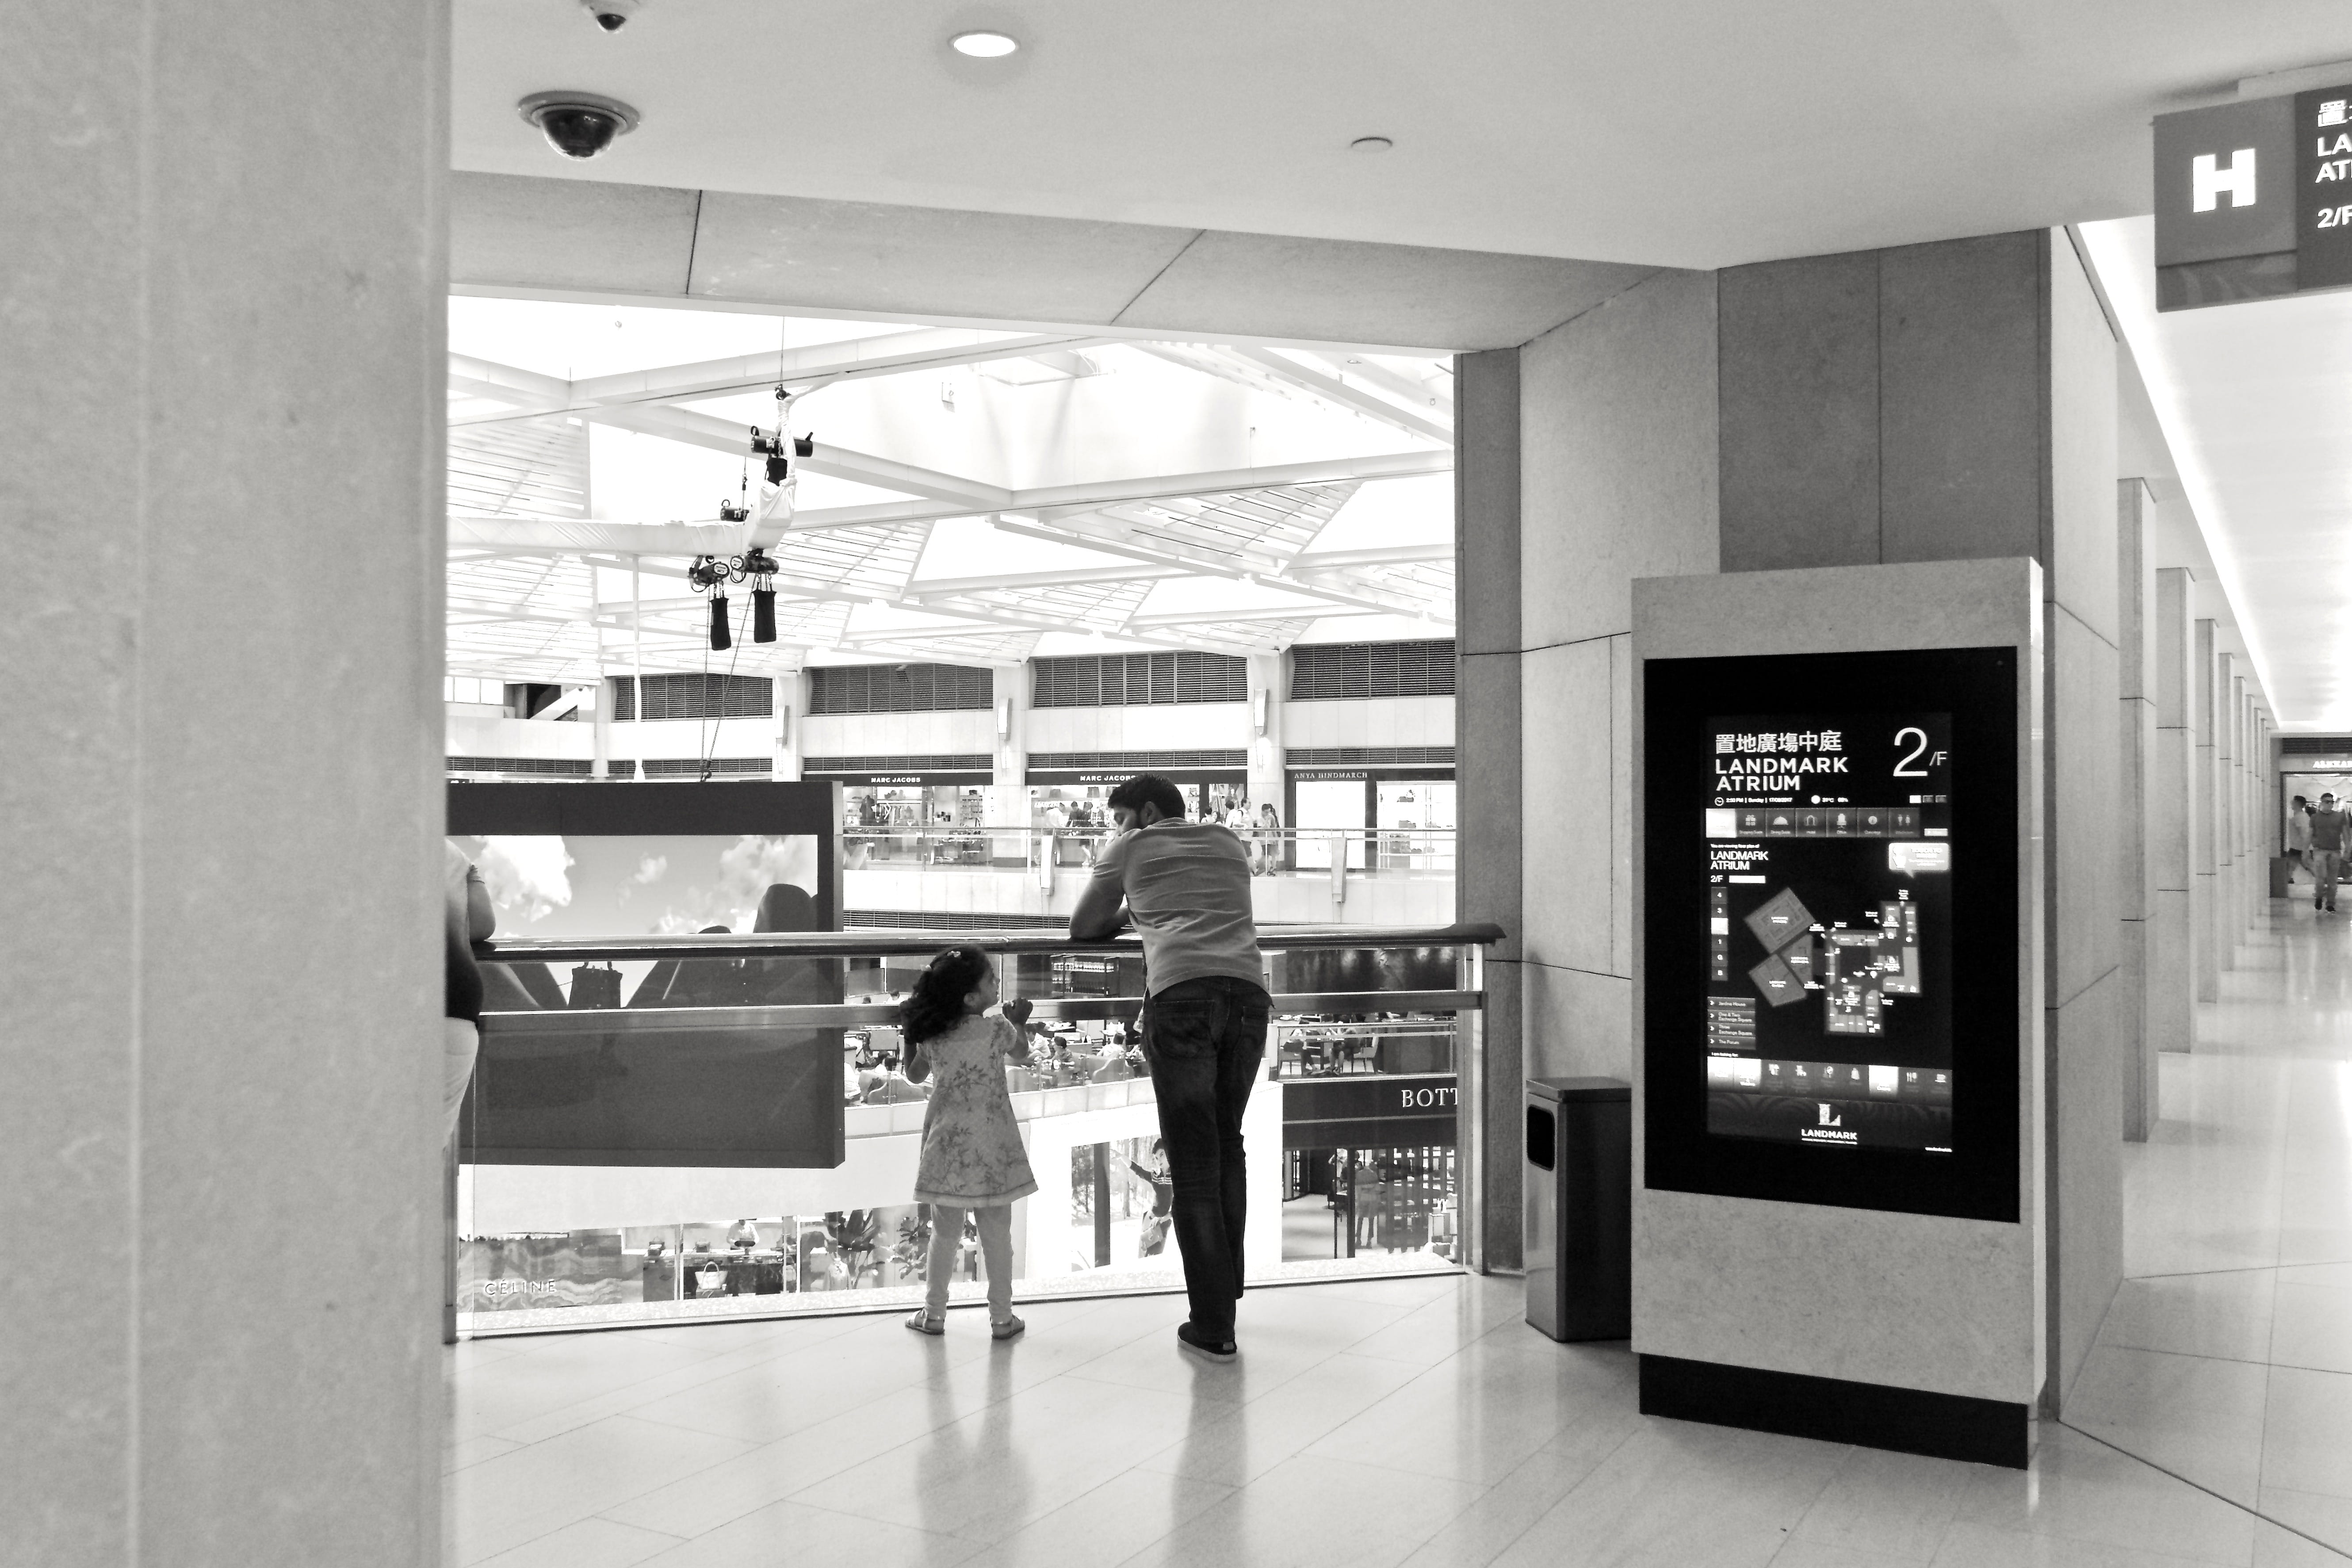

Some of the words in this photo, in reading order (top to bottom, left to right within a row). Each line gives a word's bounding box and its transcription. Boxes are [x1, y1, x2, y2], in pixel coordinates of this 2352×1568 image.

[2318, 100, 2352, 127] 置
[2315, 159, 2352, 183] AT
[2193, 149, 2256, 212] H
[2318, 205, 2352, 228] 2/F
[1716, 757, 1848, 774] LANDMARK
[1716, 776, 1800, 791] ATRIUM
[1711, 851, 1768, 860] LANDMARK
[1710, 860, 1750, 870] ATRIUM
[1401, 1088, 1457, 1107] BOTT
[1801, 1129, 1857, 1140] LANDMARK
